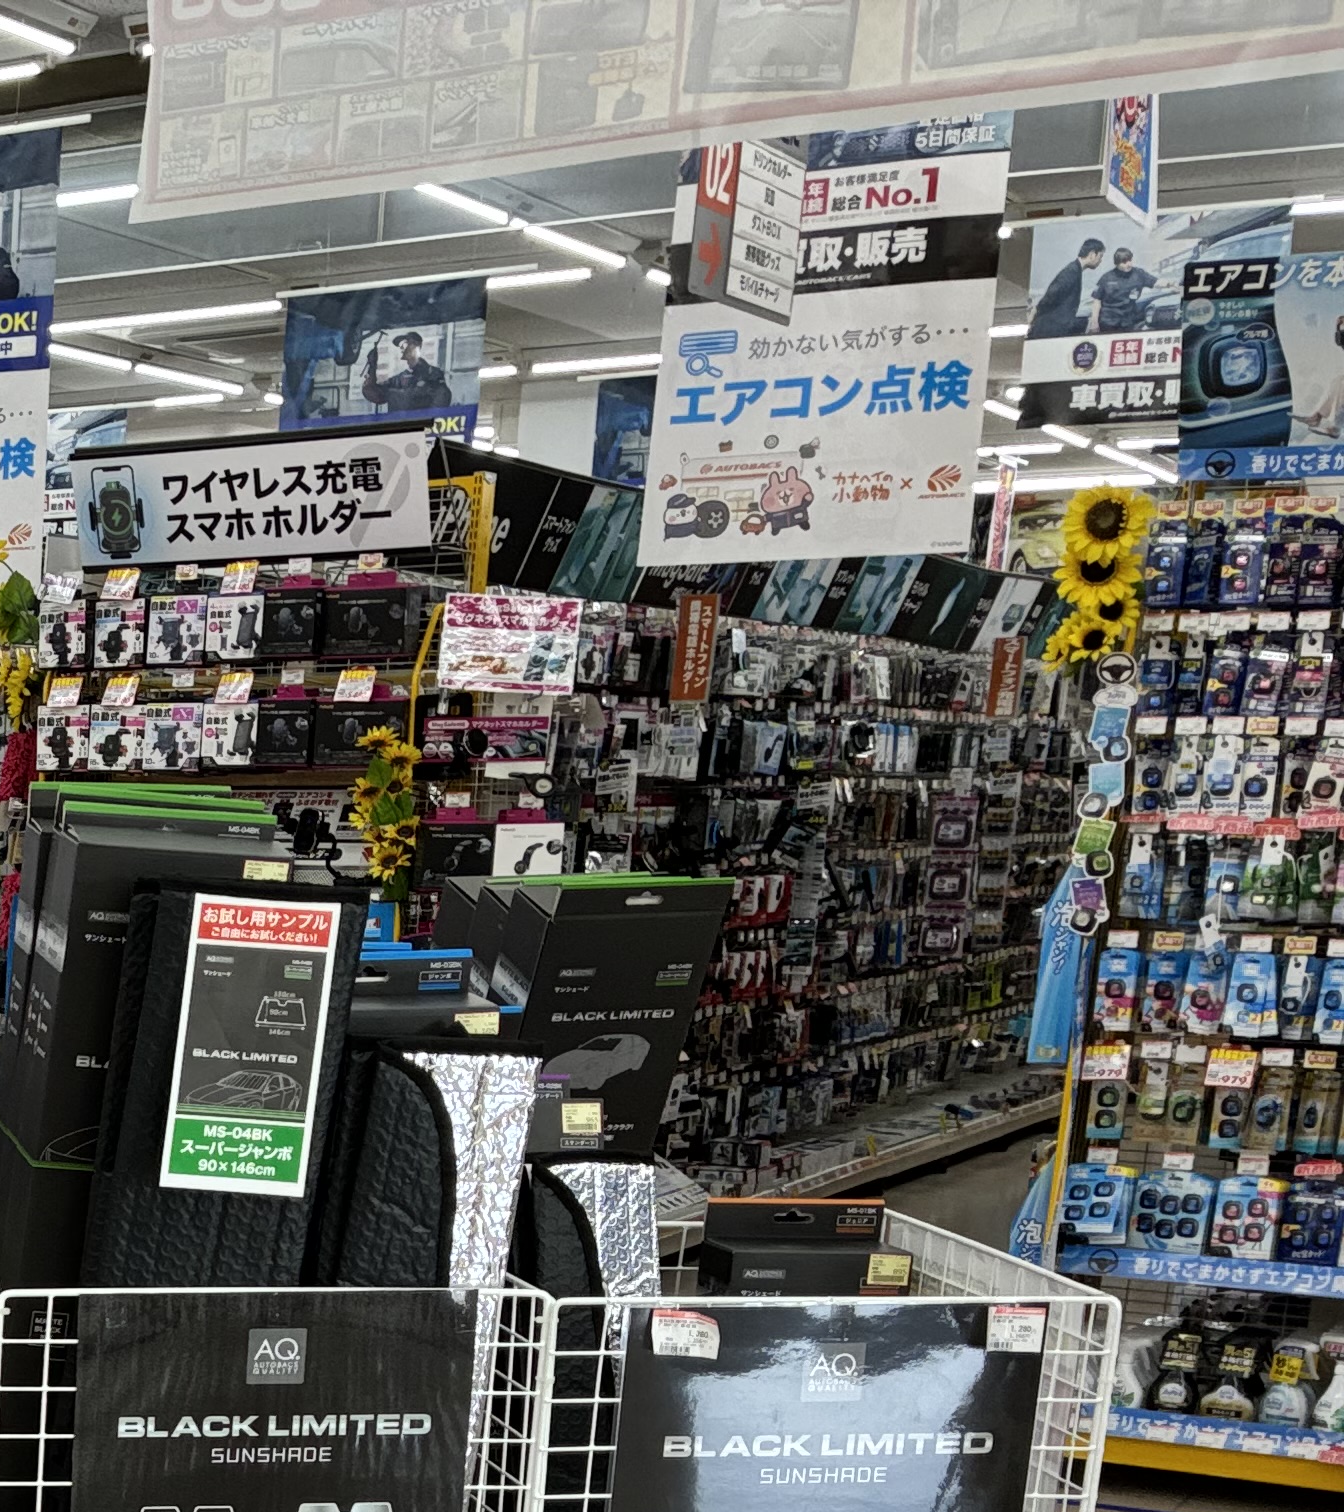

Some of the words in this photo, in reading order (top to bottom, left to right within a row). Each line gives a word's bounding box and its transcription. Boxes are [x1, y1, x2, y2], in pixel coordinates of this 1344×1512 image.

[831, 195, 862, 211] 総合
[865, 167, 940, 209] No.1
[834, 170, 900, 187] お客様満足度
[670, 361, 973, 426] エアコン点検
[162, 457, 384, 504] ワイヤレス充電
[832, 483, 890, 503] 小動物
[167, 506, 393, 544] スマホホルダー
[203, 907, 328, 930] お試し用サンプル
[211, 927, 318, 943] ご自由にお試しください!
[551, 1010, 607, 1022] BLACK
[610, 1008, 675, 1020] LIMITED
[204, 1125, 272, 1140] MS-04BK
[180, 1140, 292, 1160] スーパージャンボ
[117, 1415, 259, 1439] BLACK
[269, 1414, 431, 1436] LIMITED
[211, 1447, 331, 1463] SUNSHADE
[663, 1434, 811, 1458] BLACK
[821, 1432, 994, 1455] LIMITED
